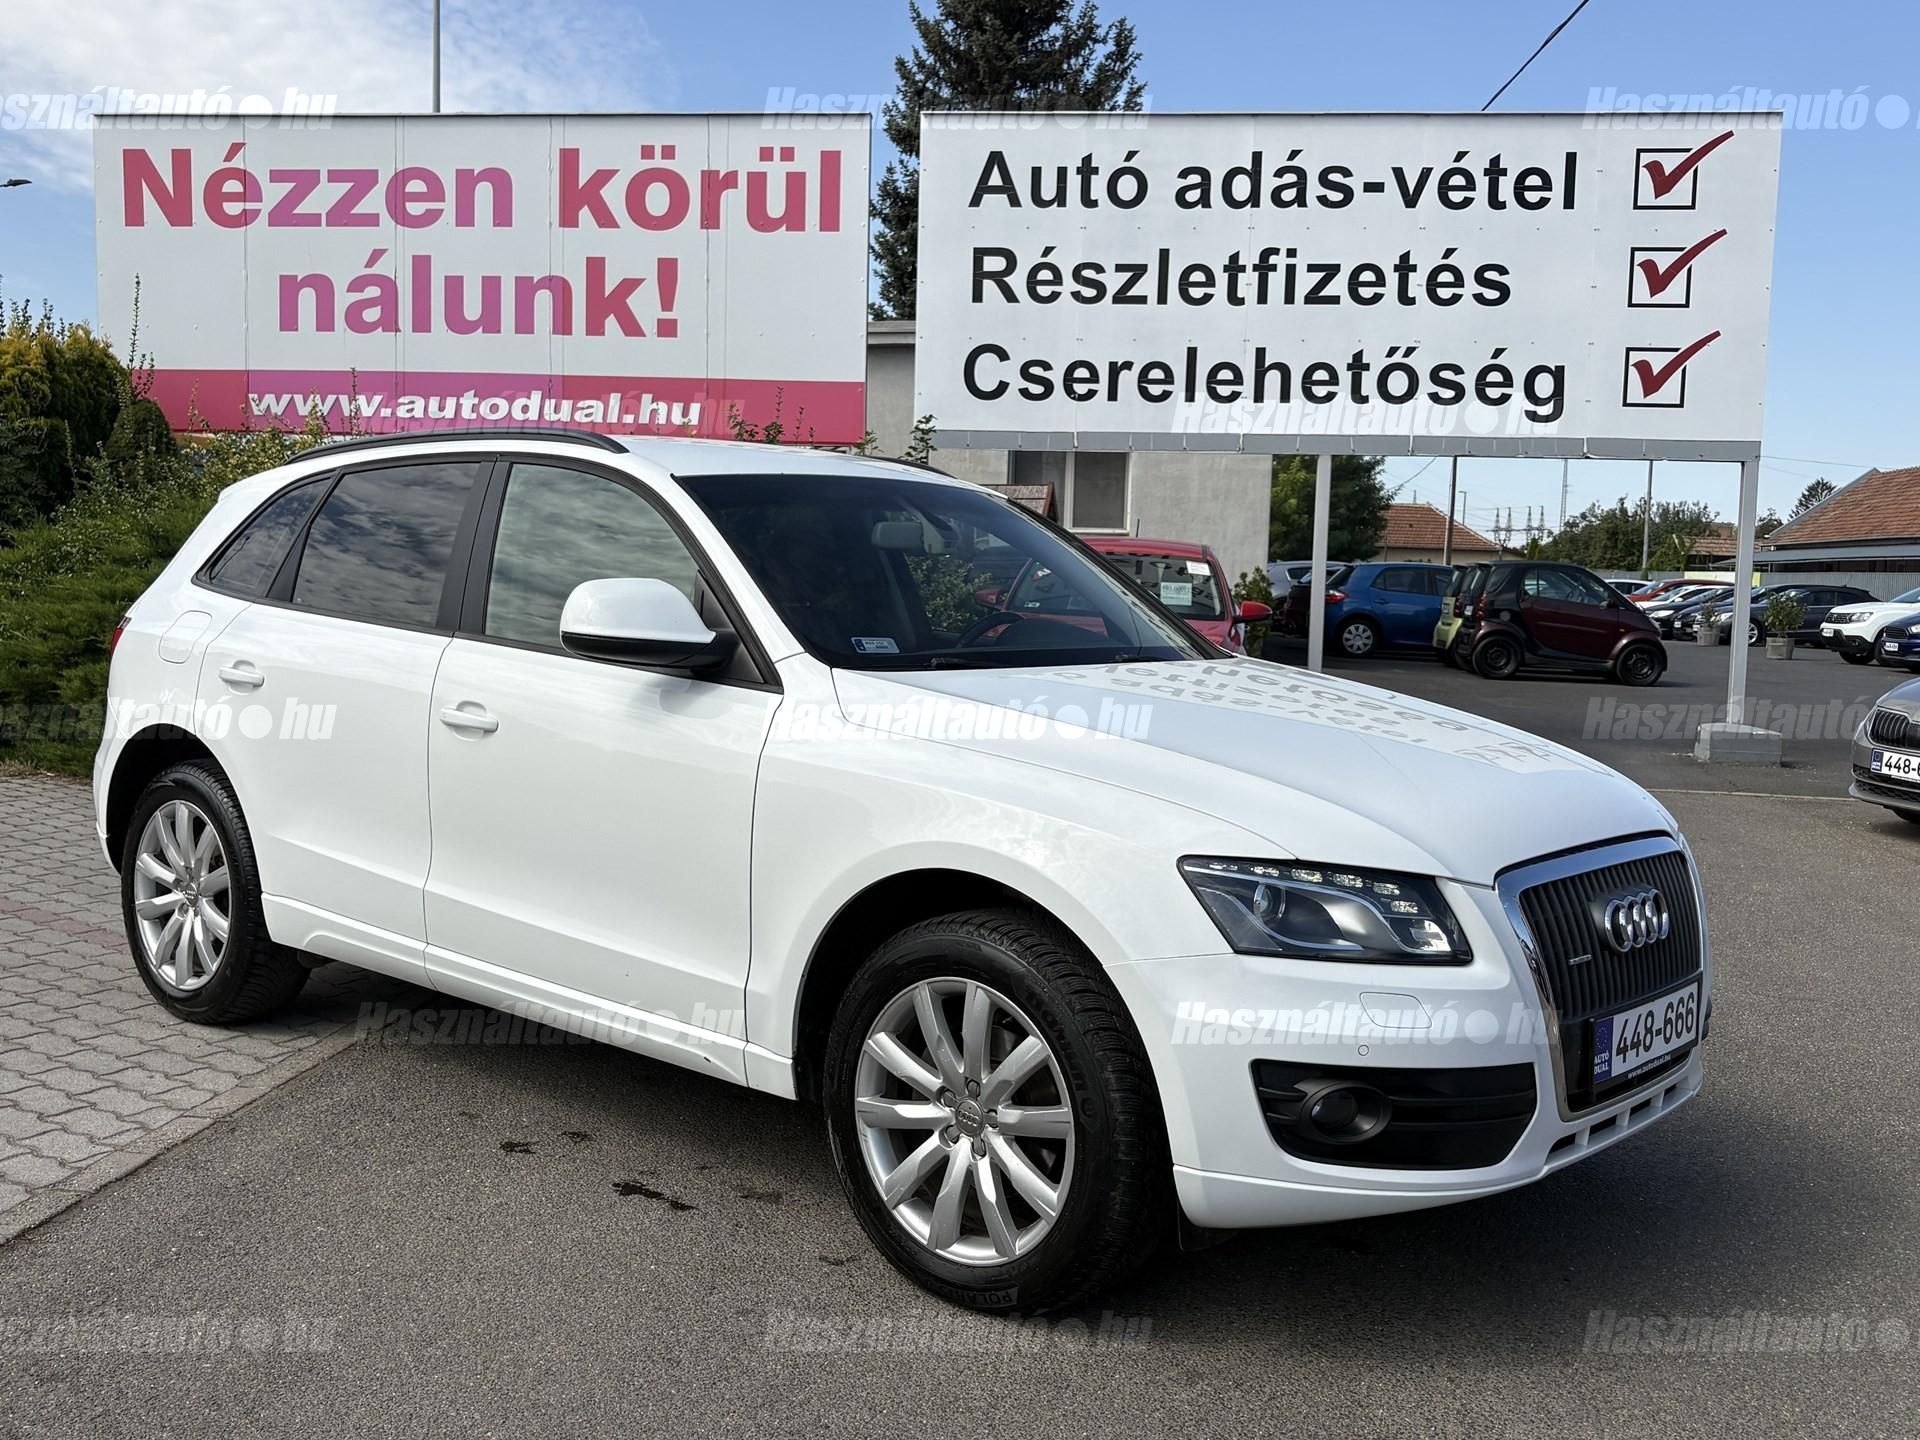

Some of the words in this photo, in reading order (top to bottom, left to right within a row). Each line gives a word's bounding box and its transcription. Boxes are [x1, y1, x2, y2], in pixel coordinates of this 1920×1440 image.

[124, 142, 512, 228] Nézzen
[559, 145, 841, 232] körül
[968, 150, 1148, 210] Autó
[1175, 149, 1578, 211] adás-vétel
[279, 249, 678, 338] nálunk!
[972, 246, 1511, 307] Részletfizetés
[248, 388, 702, 426] www.autodual.hu
[963, 343, 1565, 424] Cserelehetőség
[1615, 991, 1695, 1064] 448-666
